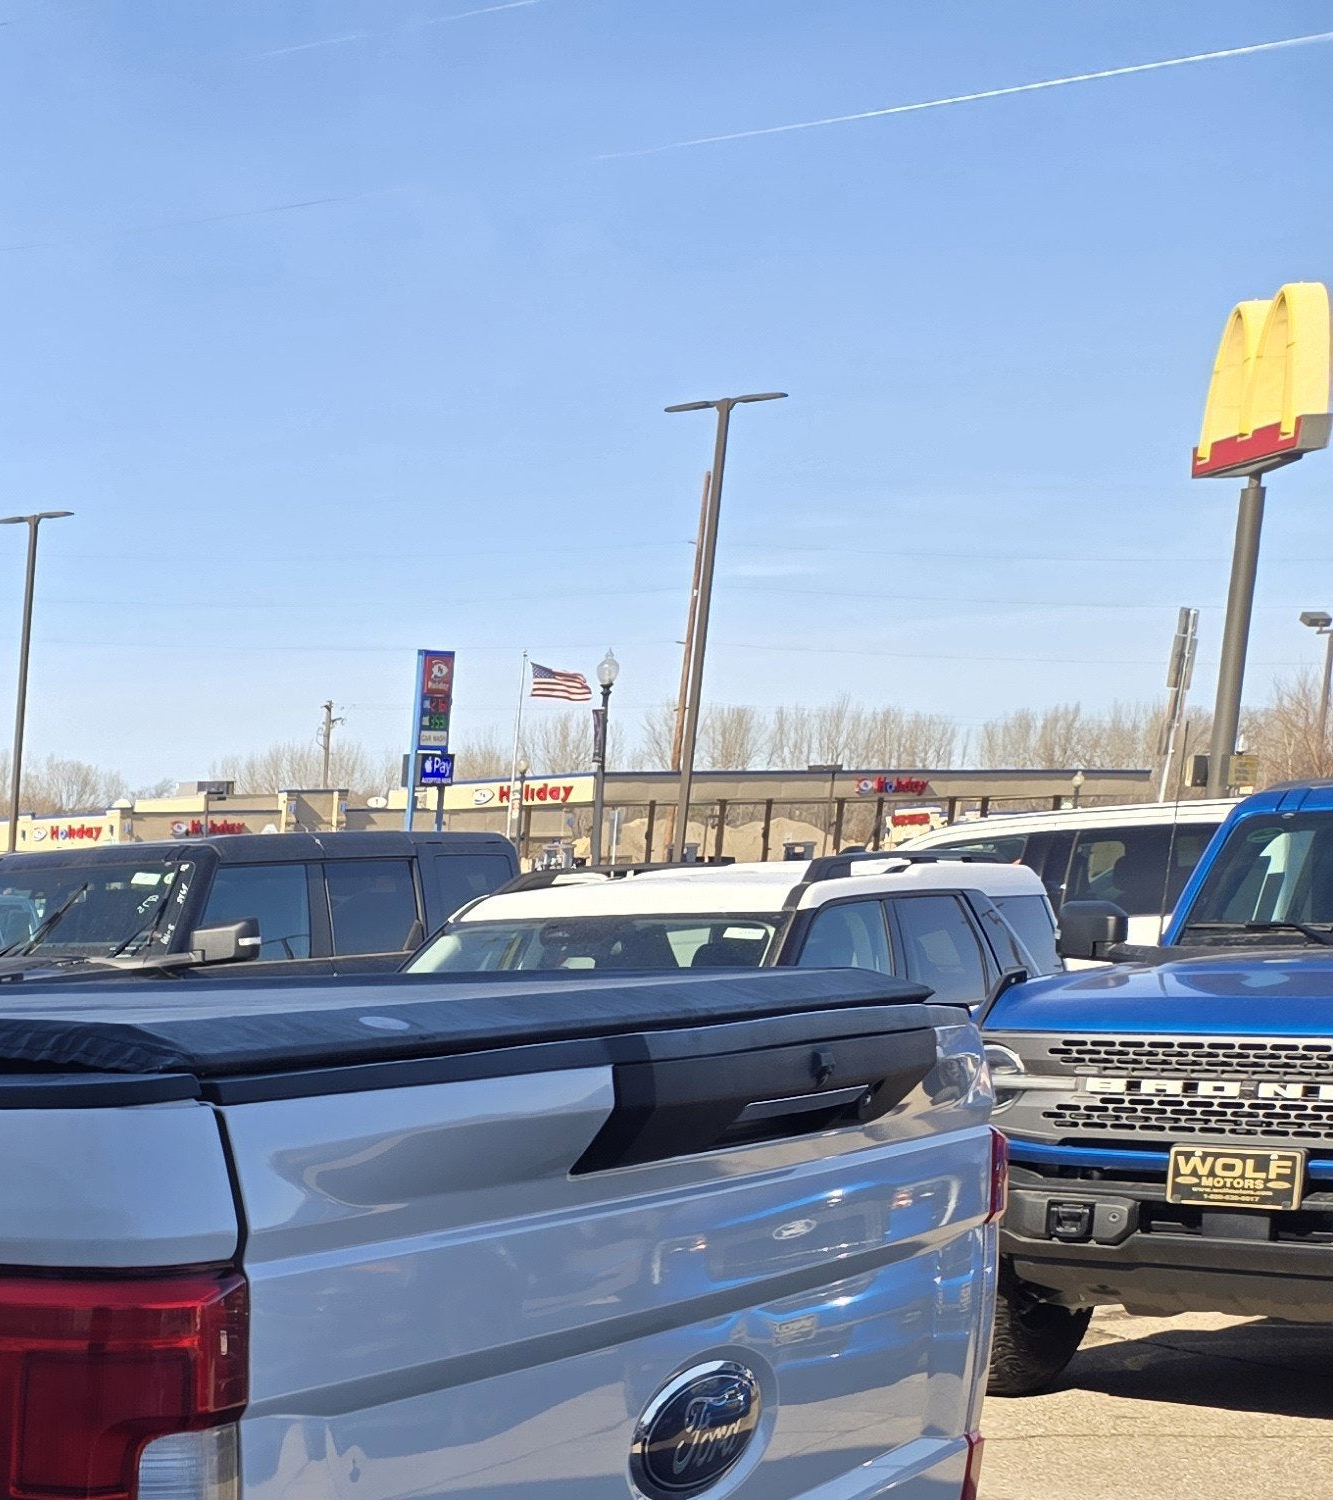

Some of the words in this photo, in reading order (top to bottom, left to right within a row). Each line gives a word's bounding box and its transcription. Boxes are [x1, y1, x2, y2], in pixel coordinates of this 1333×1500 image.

[434, 757, 451, 776] Pay
[1177, 1155, 1293, 1179] WOLF
[1201, 1177, 1265, 1189] MOTORS
[673, 1384, 747, 1475] Ford
